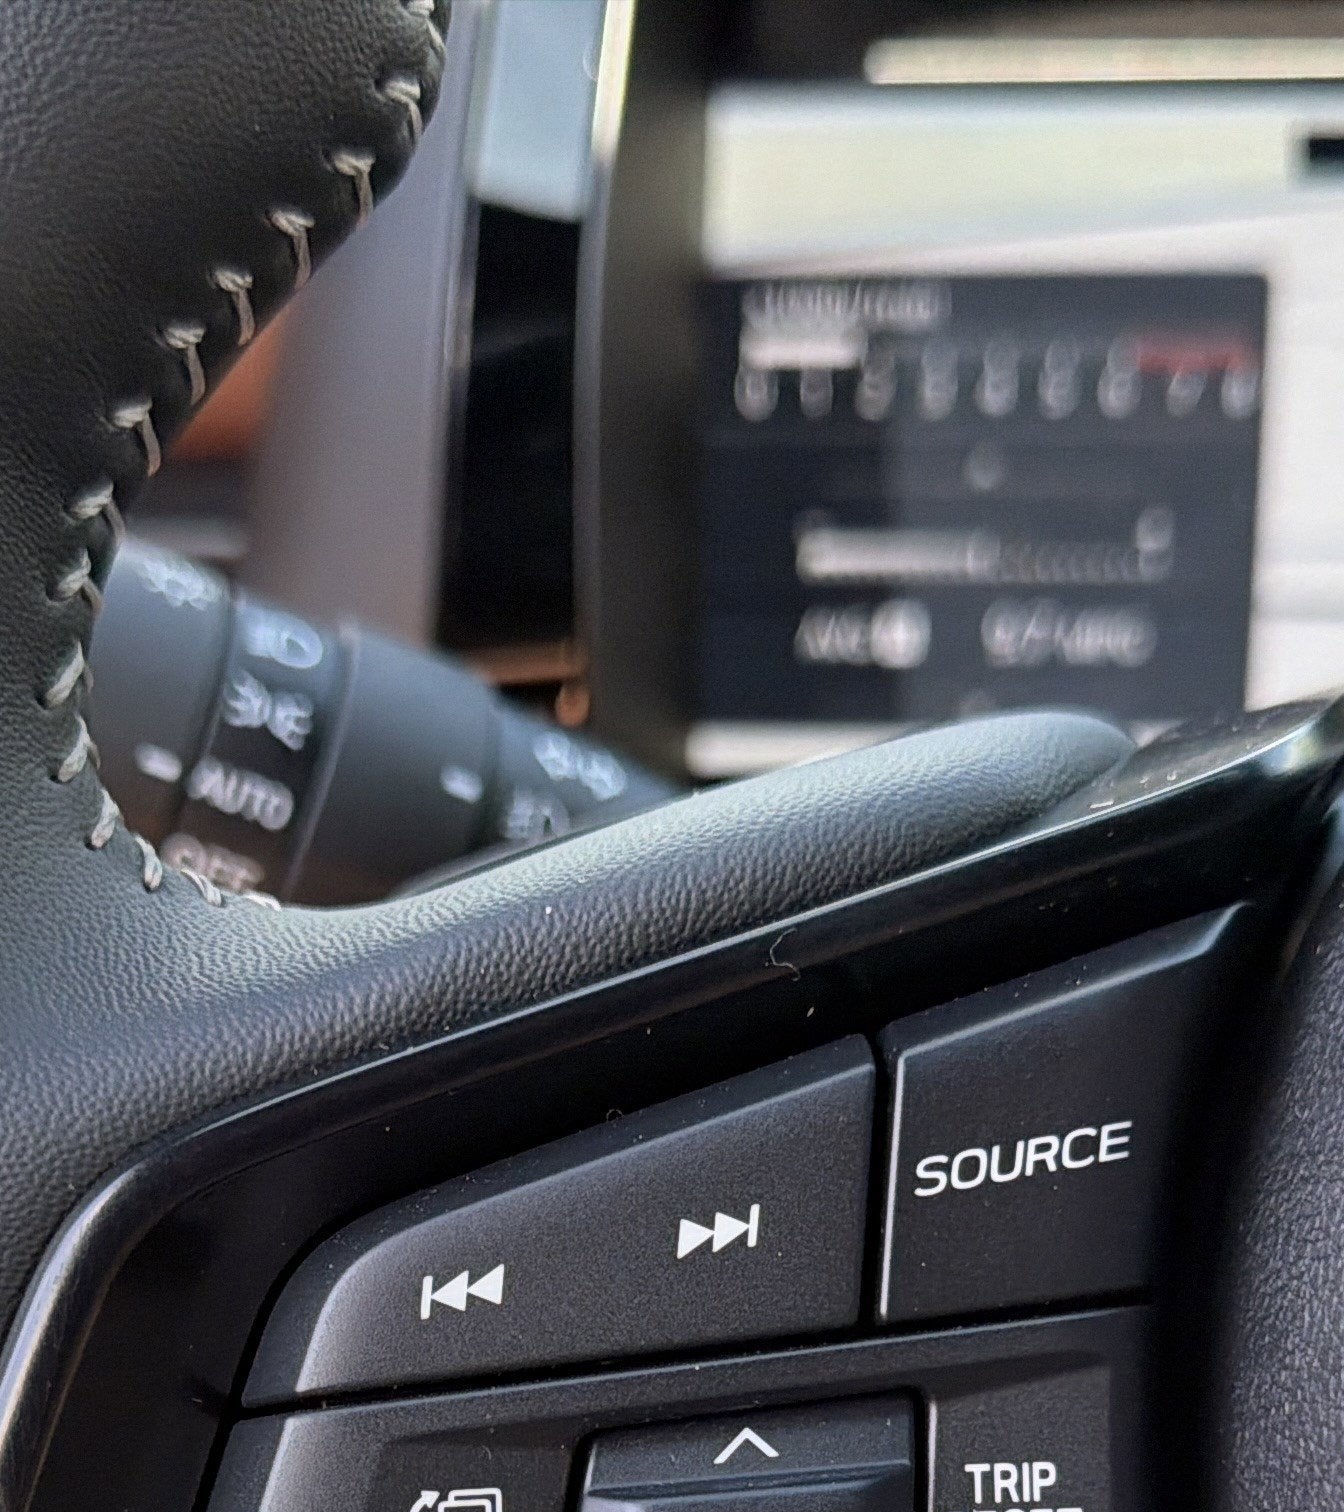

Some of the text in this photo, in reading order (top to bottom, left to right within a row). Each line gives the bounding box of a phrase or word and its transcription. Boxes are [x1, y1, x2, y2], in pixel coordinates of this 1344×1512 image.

[187, 756, 293, 831] AUTO
[913, 1120, 1133, 1197] SOURCE
[964, 1460, 1057, 1505] TRIP
